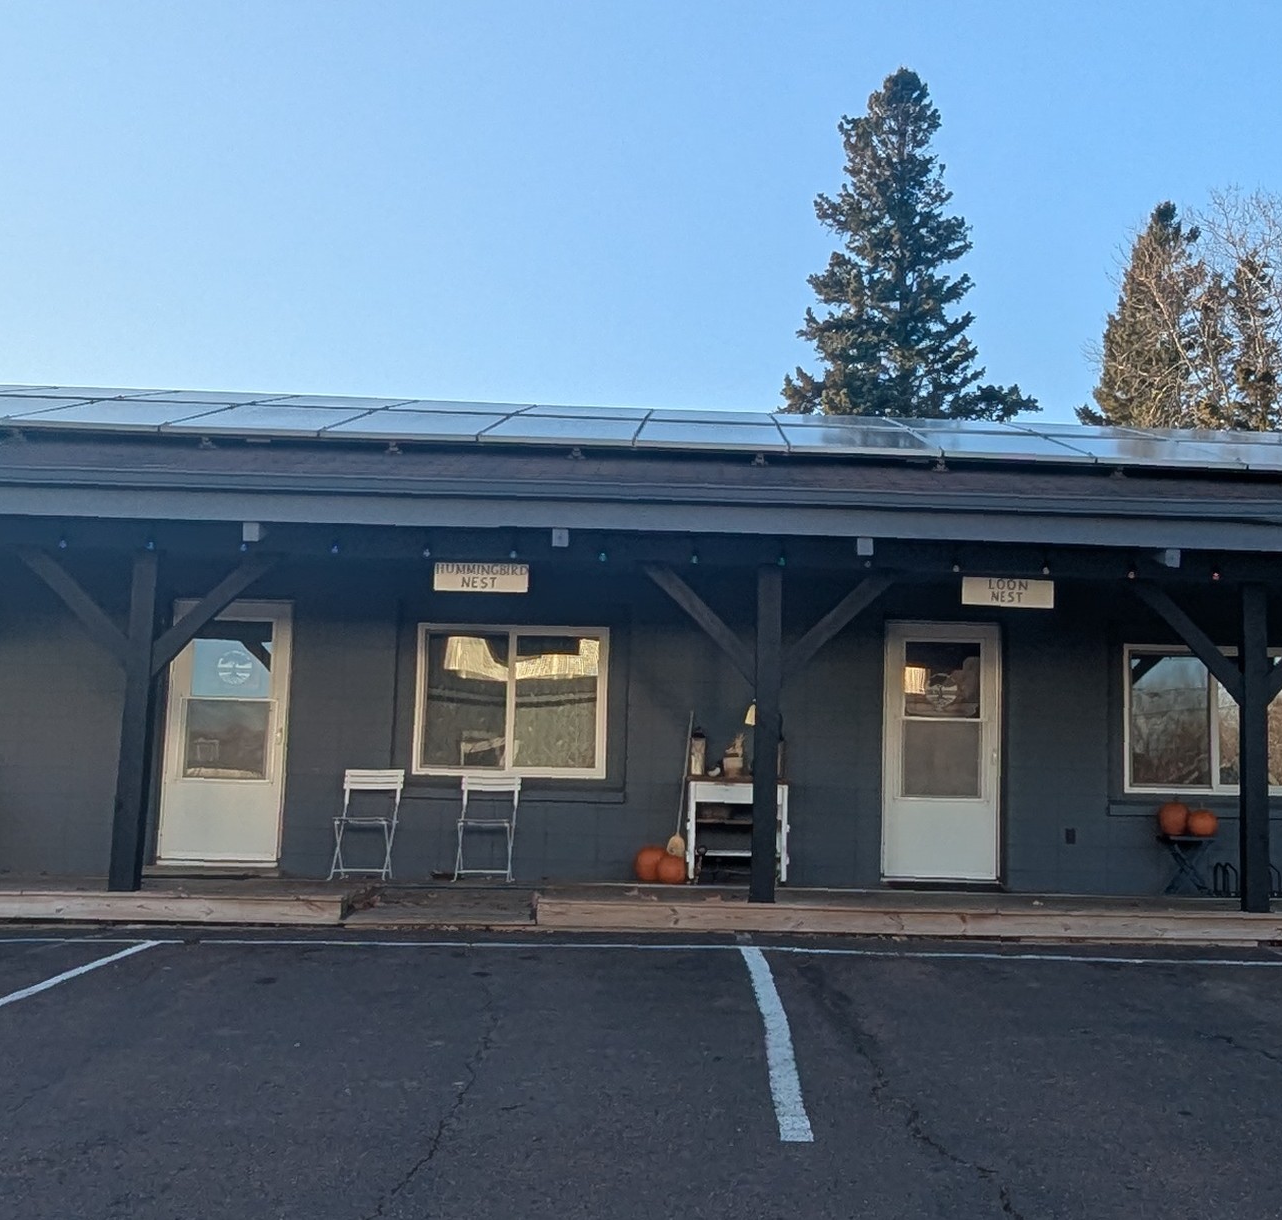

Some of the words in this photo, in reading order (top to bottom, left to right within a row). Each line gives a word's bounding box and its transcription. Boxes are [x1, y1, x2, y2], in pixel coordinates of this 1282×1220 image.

[436, 563, 529, 576] HUMMINGBIRD
[461, 576, 497, 589] NEST
[988, 578, 1029, 591] LOON
[990, 591, 1023, 603] NEST
